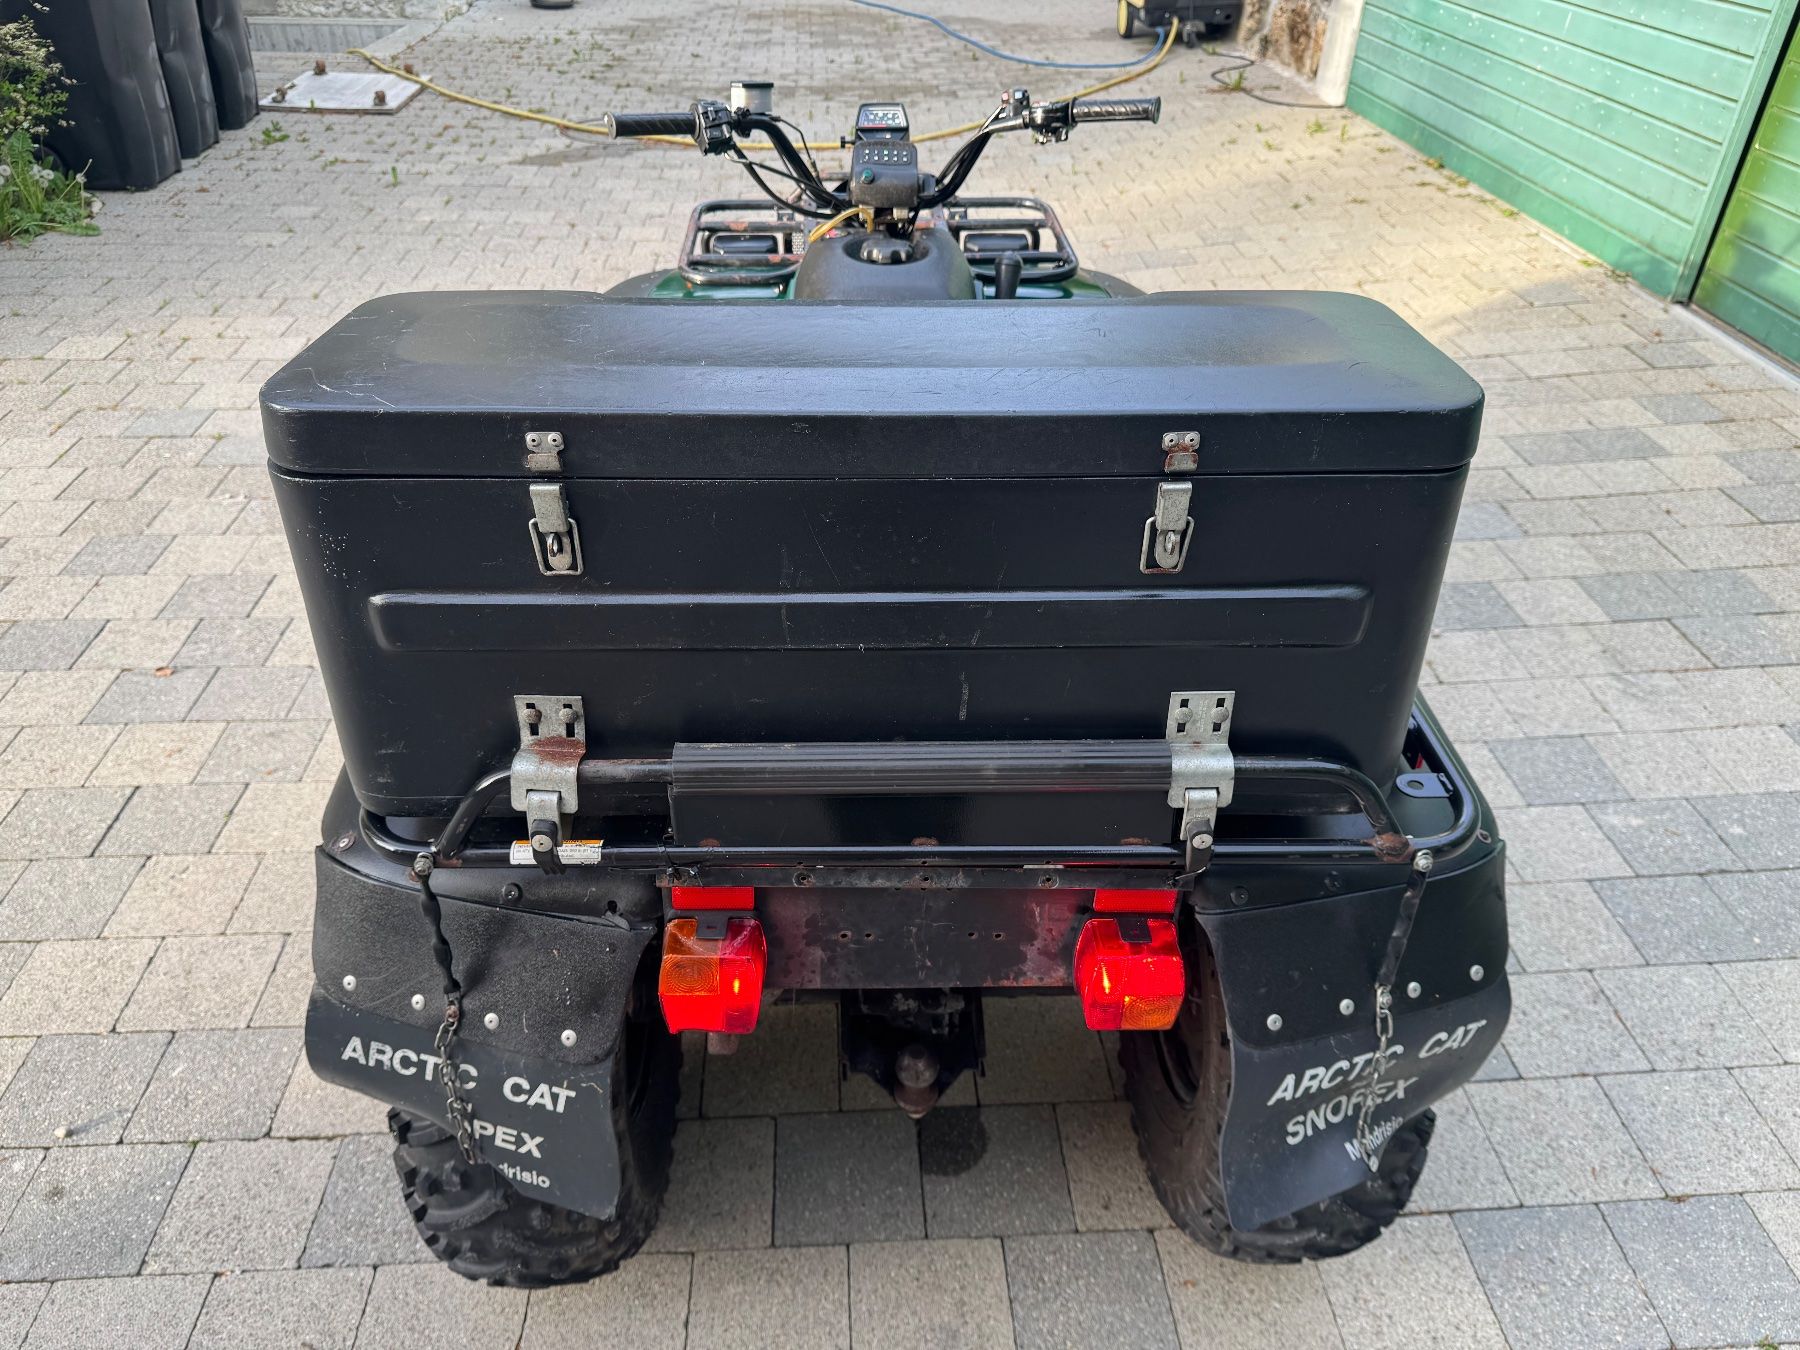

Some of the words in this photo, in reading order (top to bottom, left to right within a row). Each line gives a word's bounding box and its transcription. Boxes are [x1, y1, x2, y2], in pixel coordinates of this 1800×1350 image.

[341, 1036, 478, 1090] ARCTC
[502, 1076, 576, 1113] CAT
[1267, 1044, 1404, 1106] ARCTC
[1418, 1019, 1487, 1058] CAT
[463, 1118, 544, 1158] PEX
